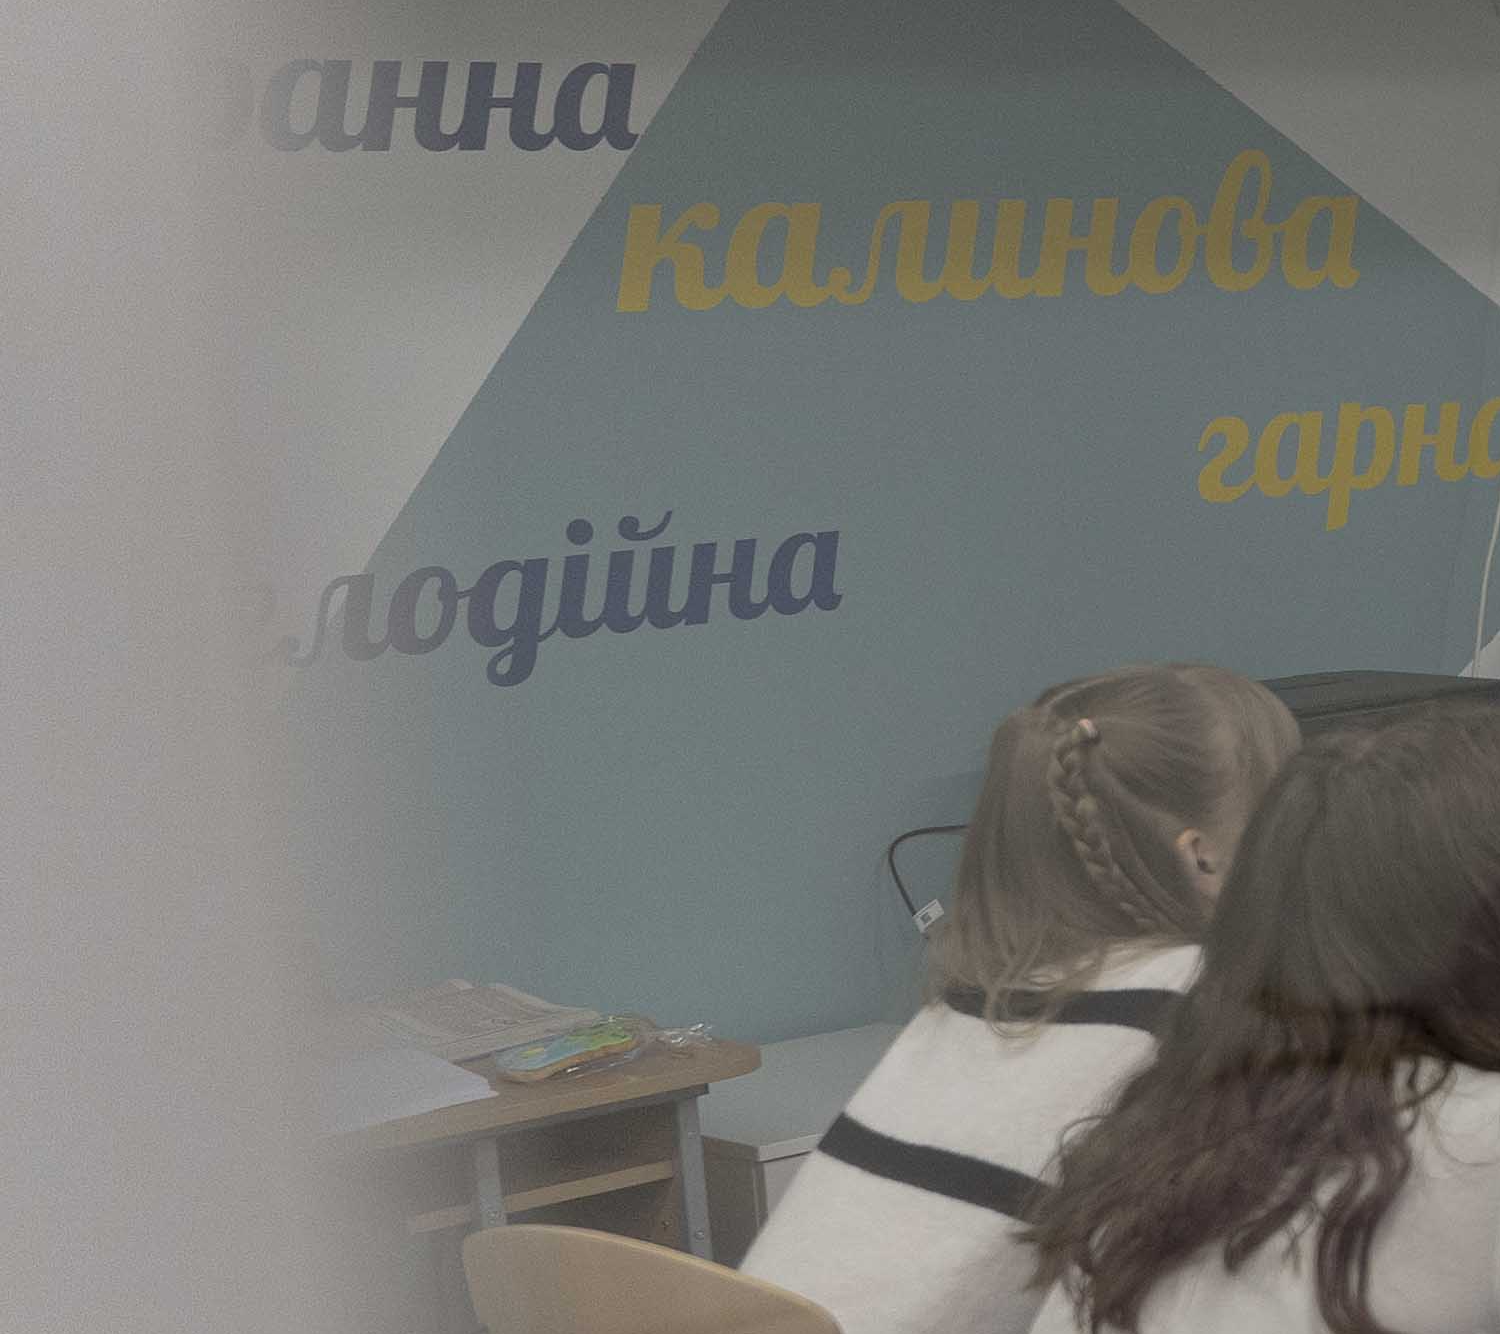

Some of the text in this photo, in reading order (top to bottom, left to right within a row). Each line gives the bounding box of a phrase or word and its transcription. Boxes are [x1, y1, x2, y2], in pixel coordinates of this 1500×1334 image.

[215, 55, 640, 155] анна
[615, 148, 1362, 314] калинова
[260, 510, 844, 689] лодійна
